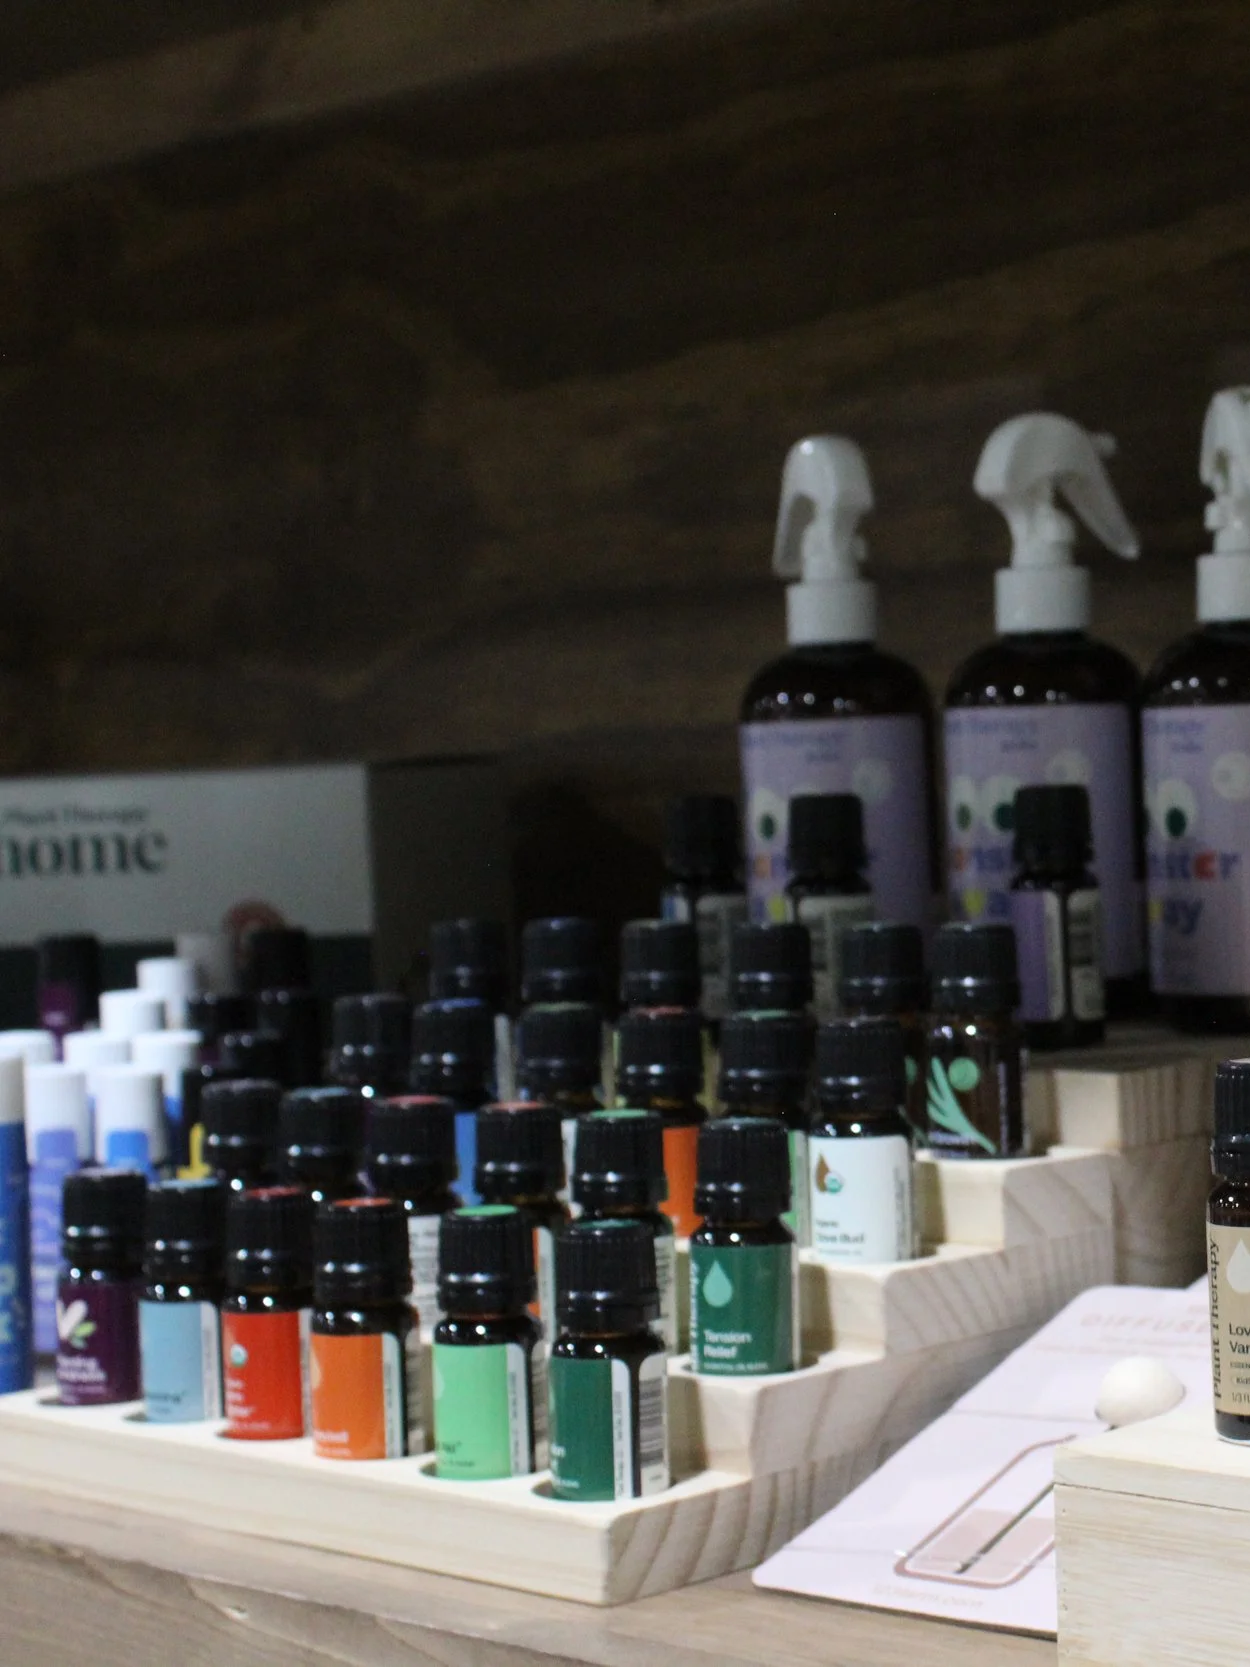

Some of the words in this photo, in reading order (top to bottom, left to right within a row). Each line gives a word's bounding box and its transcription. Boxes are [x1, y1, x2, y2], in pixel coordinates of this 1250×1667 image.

[1209, 1239, 1221, 1331] Therapy
[704, 1329, 753, 1344] Tension
[1212, 1339, 1222, 1399] Plant
[1231, 1393, 1242, 1402] 1/3
